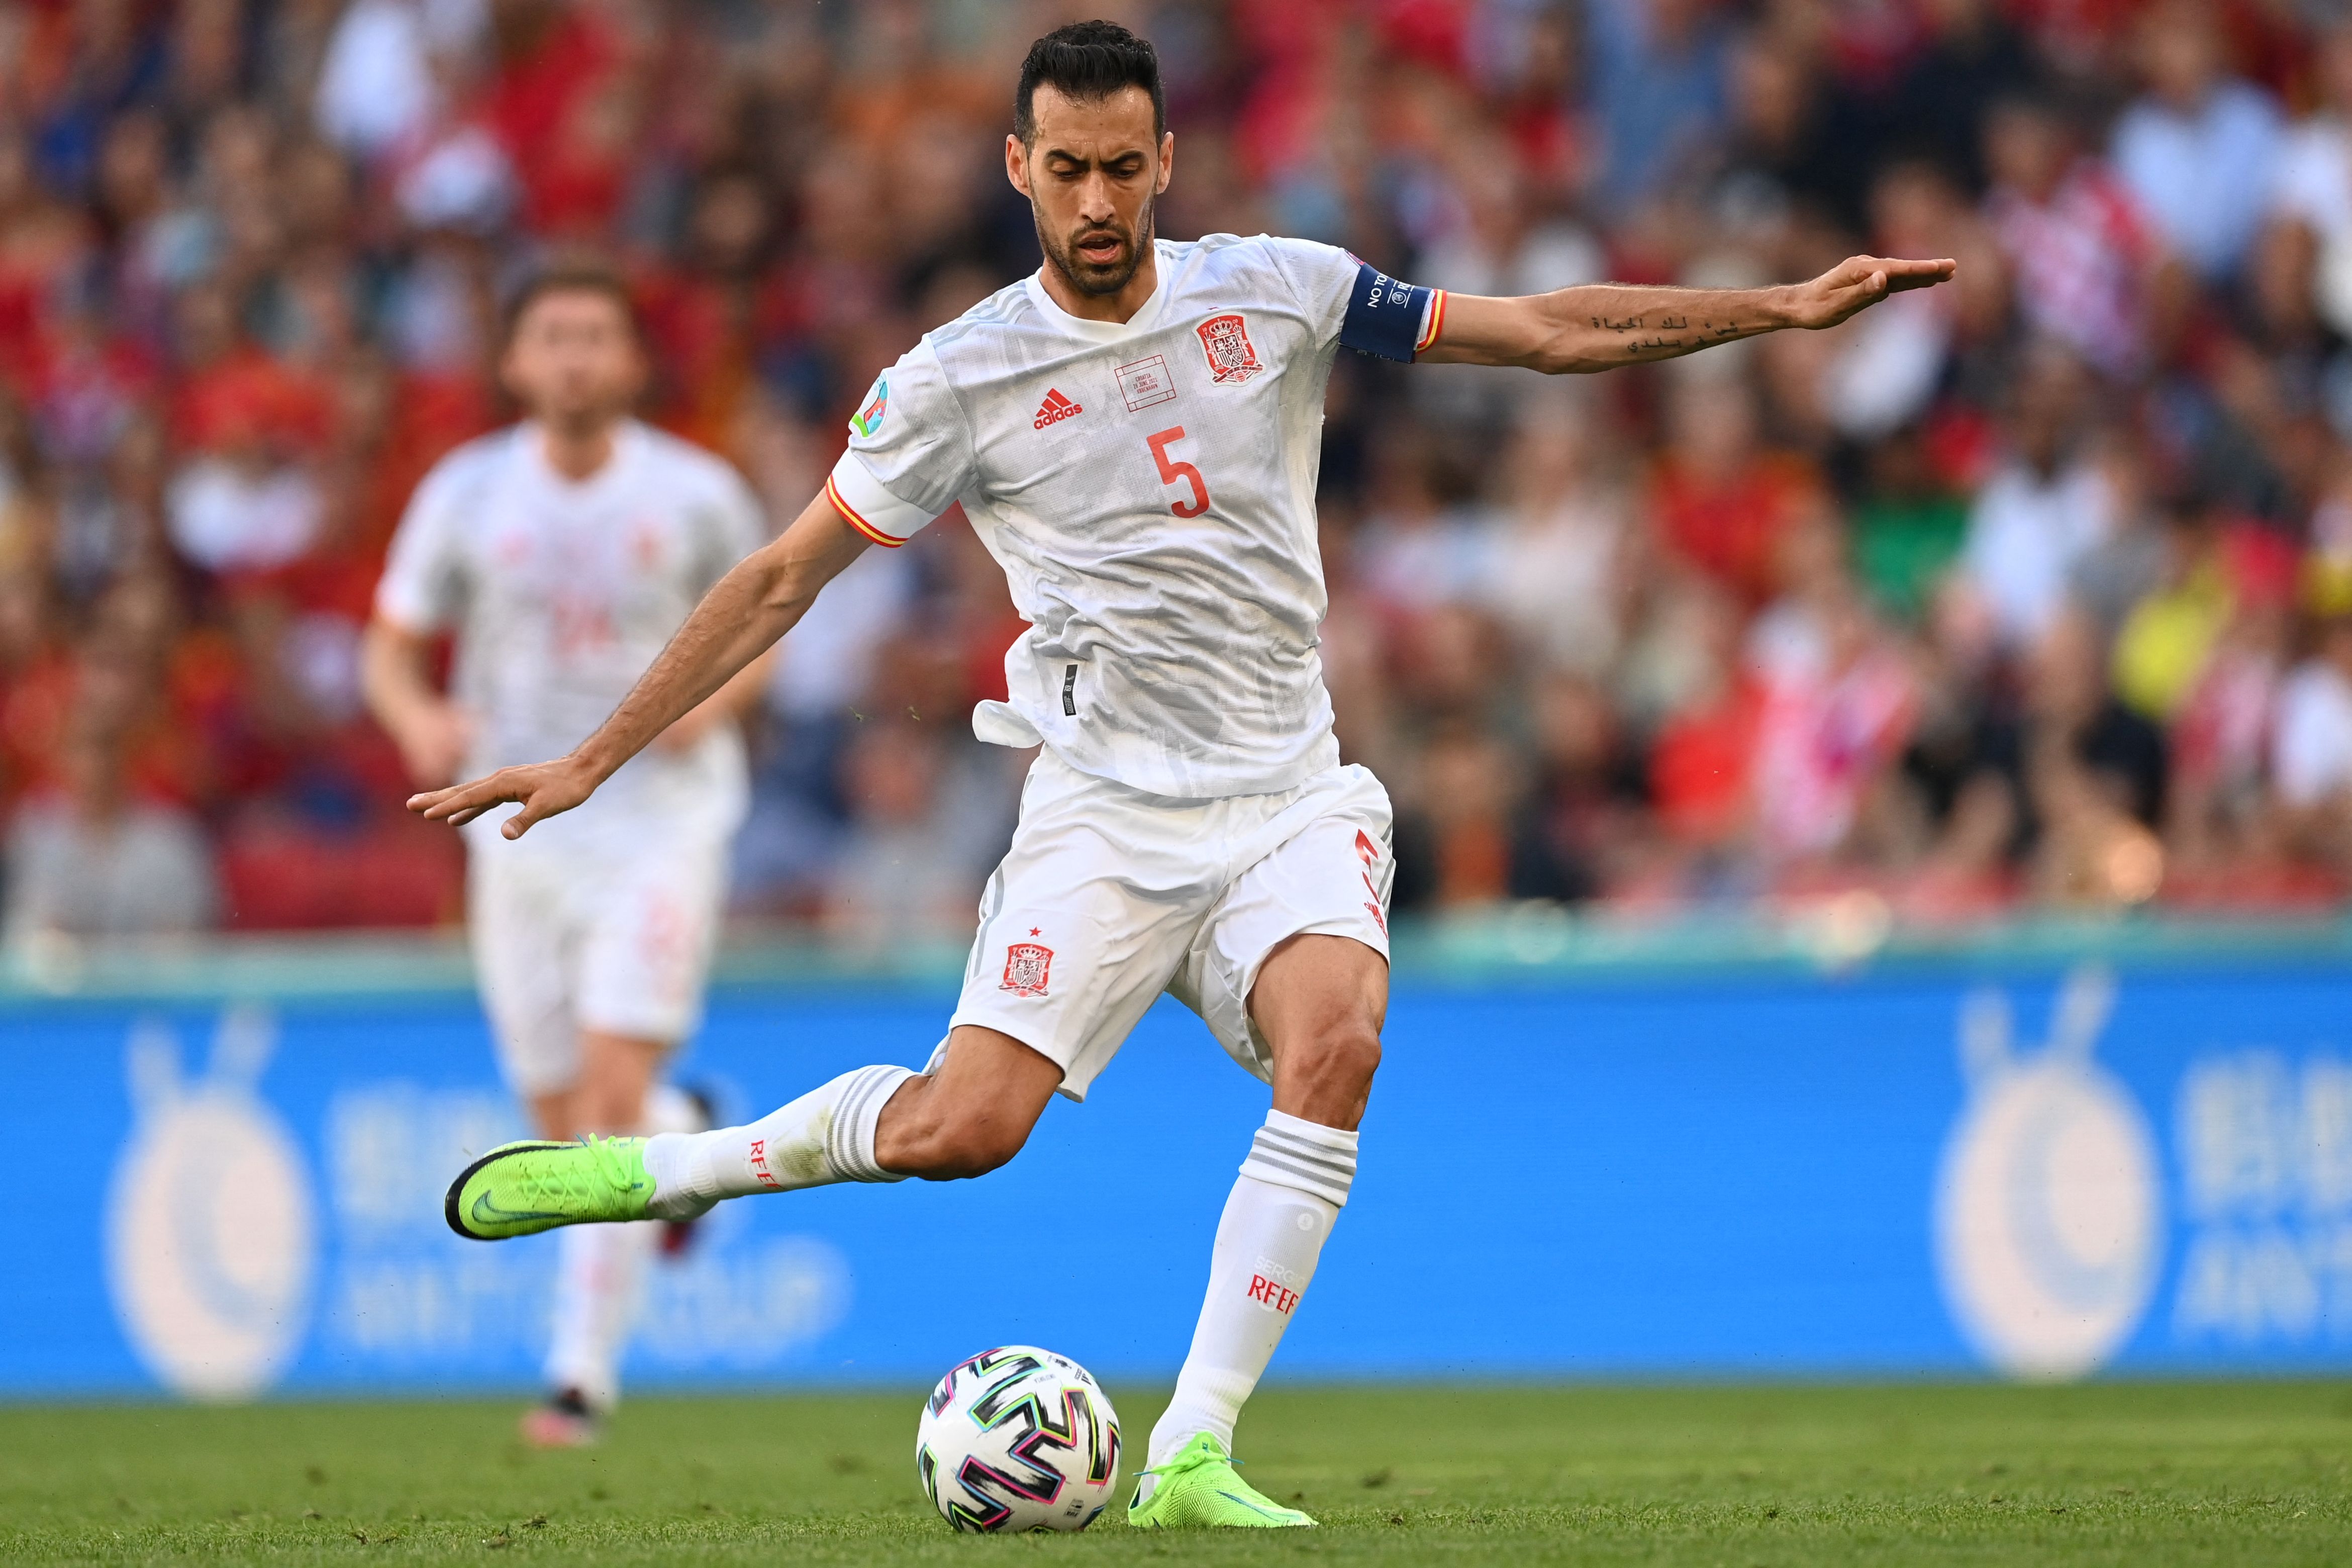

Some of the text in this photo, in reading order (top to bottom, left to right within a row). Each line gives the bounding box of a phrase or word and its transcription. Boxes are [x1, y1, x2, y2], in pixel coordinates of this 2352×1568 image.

[1367, 288, 1382, 308] NO
[1135, 373, 1151, 382] CROATIA
[1034, 404, 1083, 430] adidas
[1146, 426, 1210, 518] 5
[1247, 1273, 1299, 1315] RFEF
